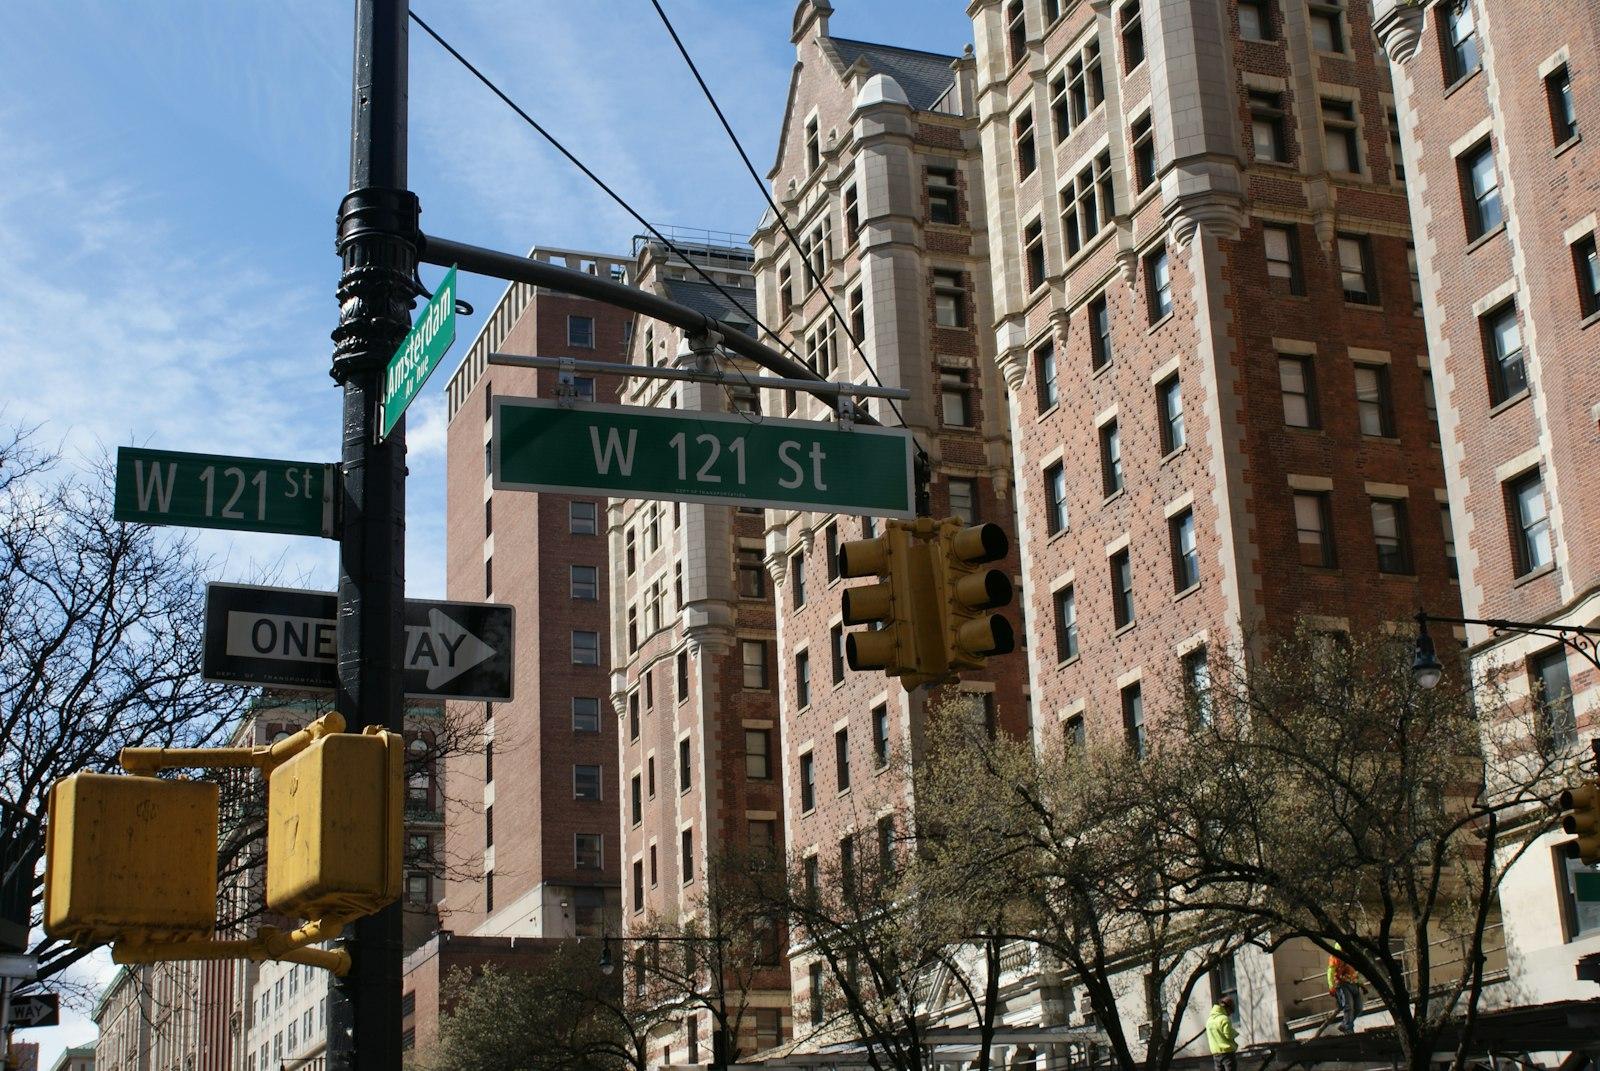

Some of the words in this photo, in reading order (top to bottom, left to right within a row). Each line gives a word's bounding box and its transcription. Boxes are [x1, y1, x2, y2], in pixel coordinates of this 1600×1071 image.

[387, 287, 451, 404] Amsterdam
[405, 355, 429, 399] Avnue
[588, 426, 638, 476] W
[669, 432, 746, 485] 121
[777, 440, 828, 491] St
[134, 460, 177, 513] W
[199, 466, 267, 521] 121
[285, 467, 313, 499] St
[251, 618, 336, 658] ONE
[405, 631, 467, 667] AY
[14, 1006, 43, 1018] WAY
